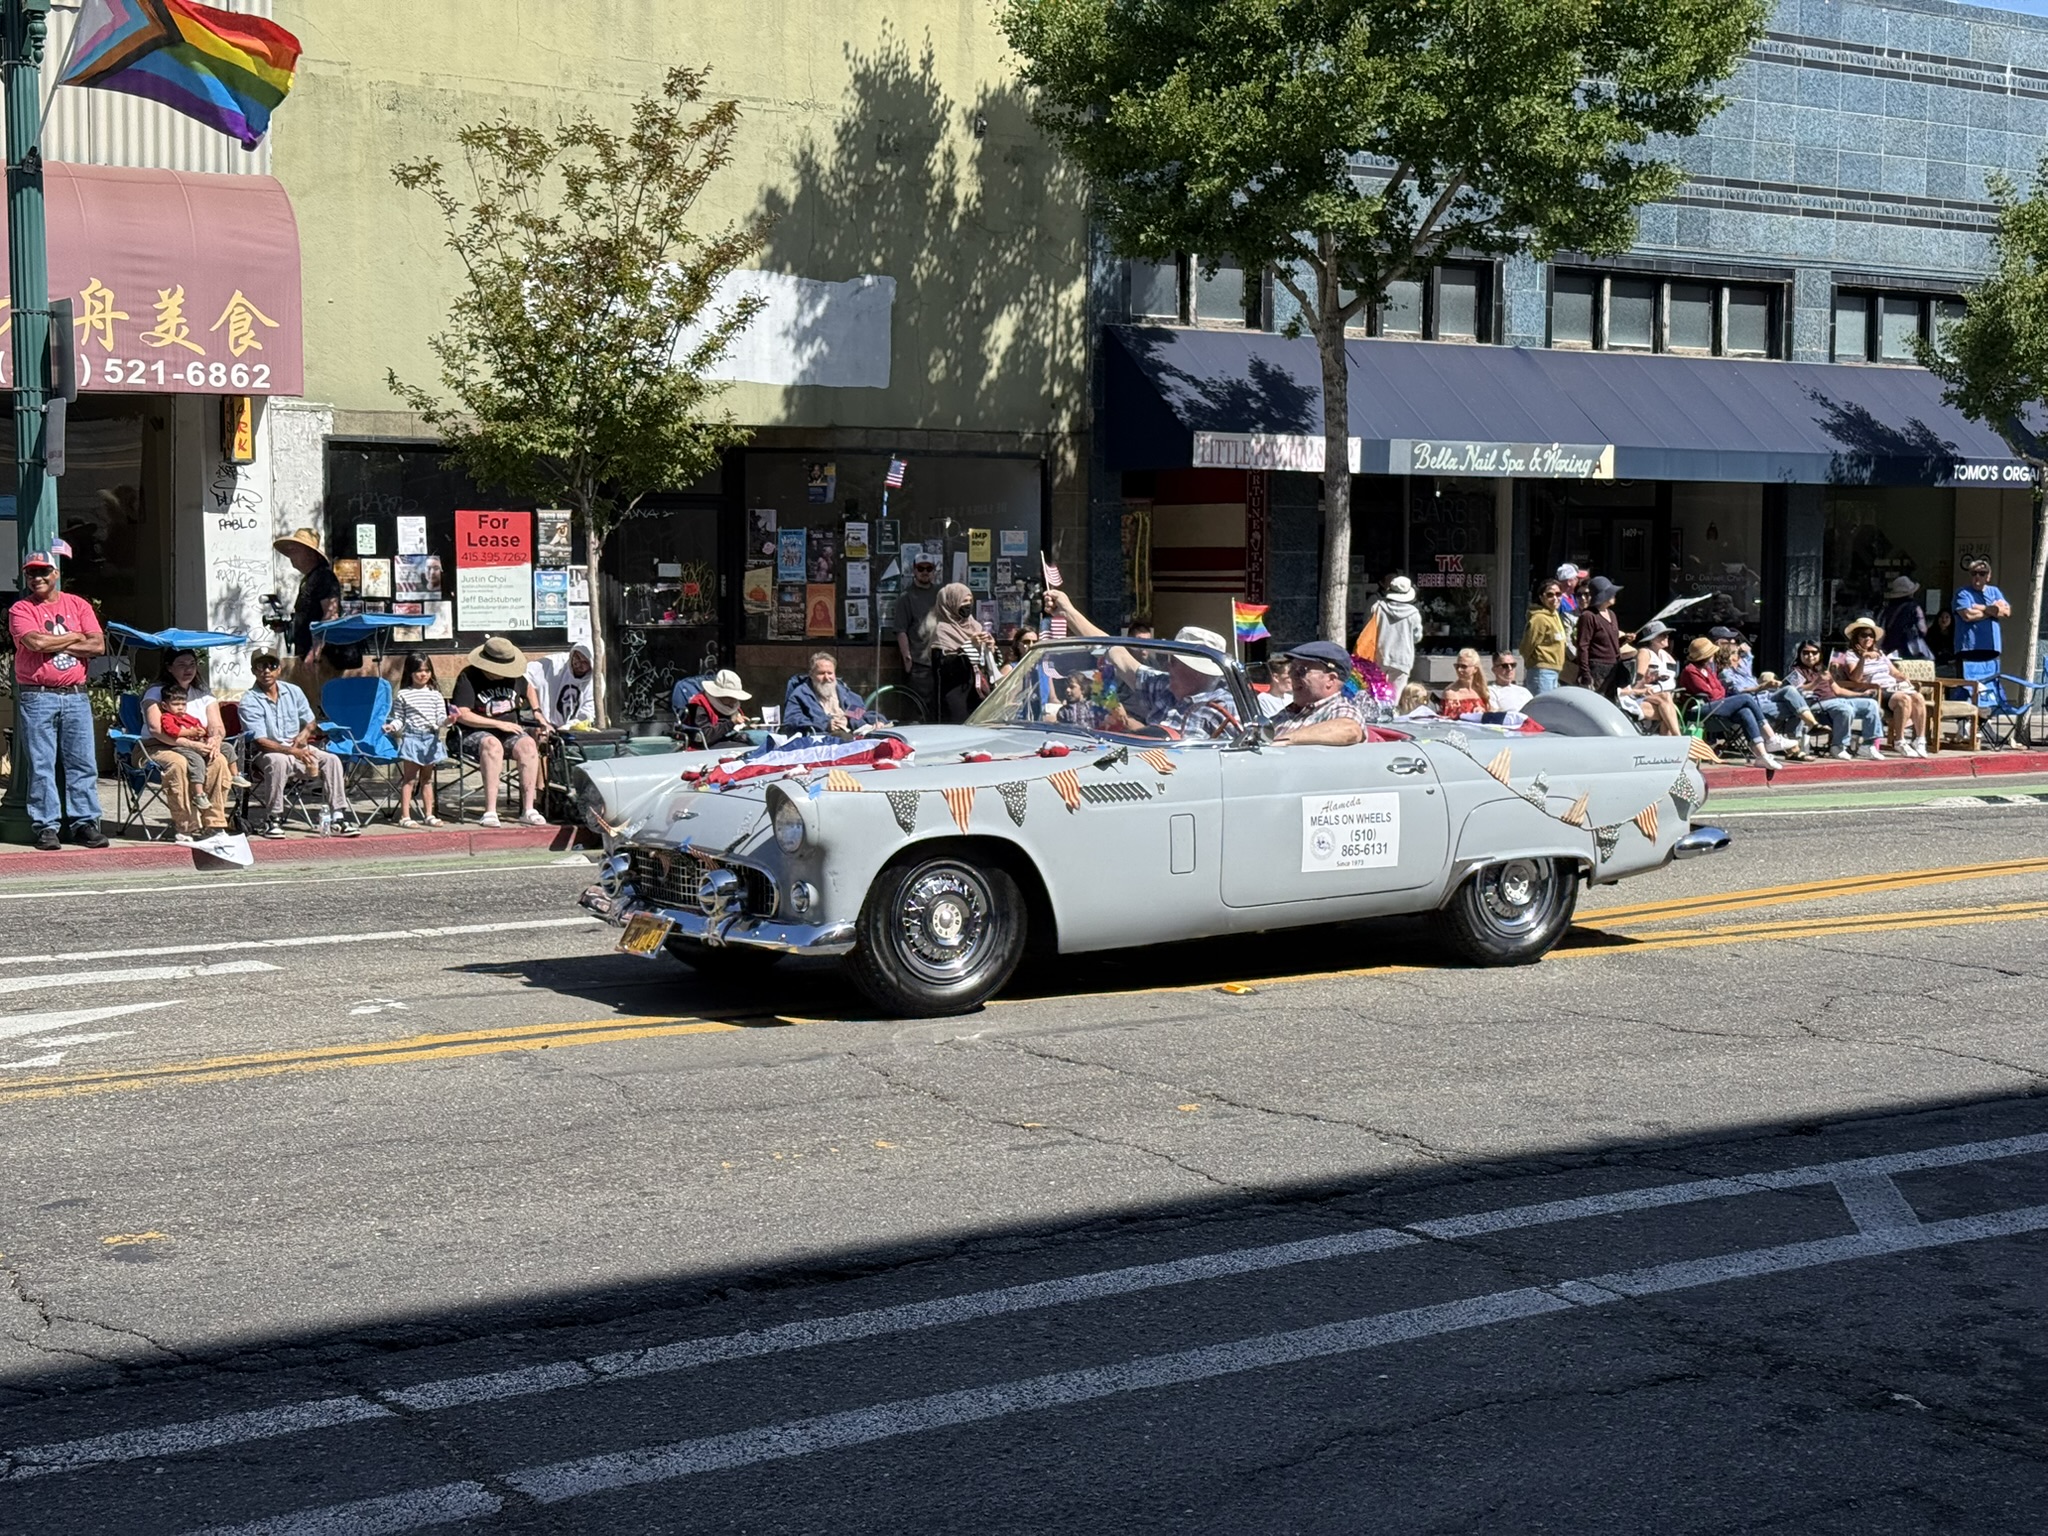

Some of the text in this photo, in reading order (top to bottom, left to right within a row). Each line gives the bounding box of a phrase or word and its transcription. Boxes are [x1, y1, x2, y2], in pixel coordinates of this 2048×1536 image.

[0, 277, 280, 358] 舟美食
[104, 358, 271, 388] 521-6862
[1201, 439, 1251, 465] LITTLE
[1414, 442, 1458, 470] Bella
[1460, 444, 1496, 472] Nail
[1499, 448, 1525, 475] Spa
[1529, 447, 1542, 472] &
[1542, 448, 1592, 478] Waxing
[1954, 464, 1998, 481] TOMO'S
[219, 518, 257, 531] PABLO
[478, 514, 509, 529] For
[467, 532, 520, 547] Lease
[461, 552, 527, 562] 415.395.7262
[1435, 554, 1464, 572] TK
[461, 575, 507, 583] Justin Choi
[461, 596, 476, 604] Jeff
[1320, 796, 1362, 814] Alameda
[1310, 812, 1392, 826] MEALS ON WHEELS
[1350, 828, 1376, 842] (510)
[1341, 842, 1388, 857] 865-6131
